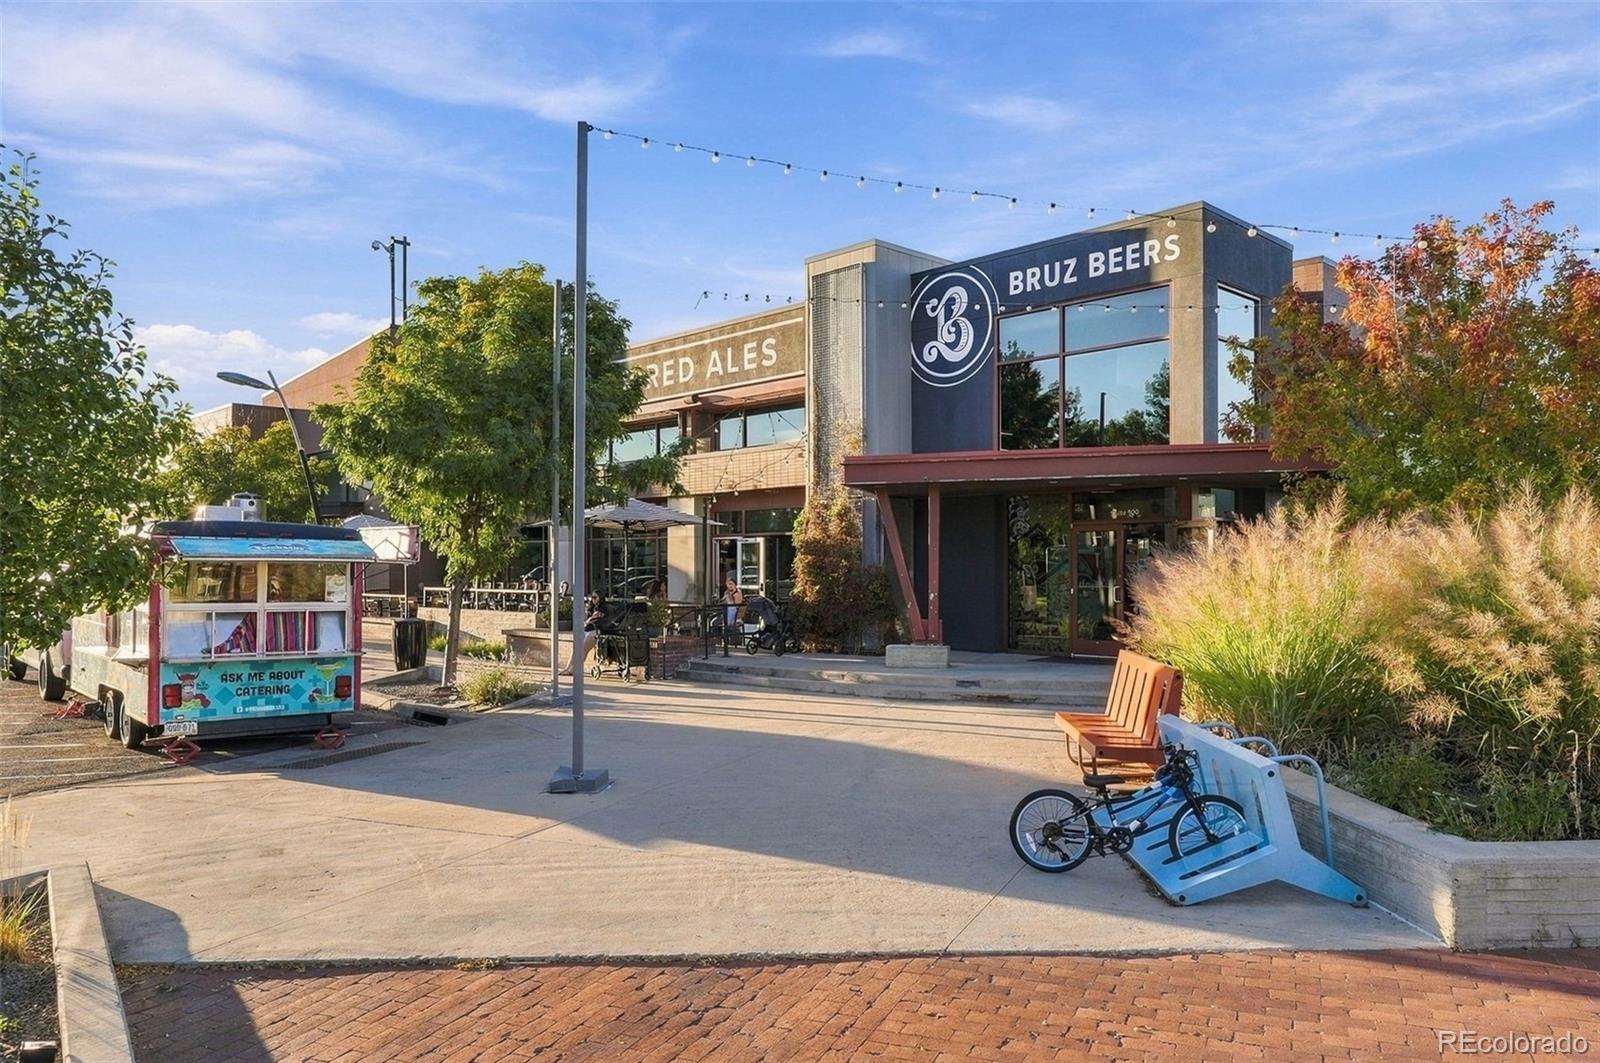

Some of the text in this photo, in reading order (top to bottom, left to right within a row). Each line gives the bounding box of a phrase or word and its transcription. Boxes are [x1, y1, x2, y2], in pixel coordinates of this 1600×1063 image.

[1008, 233, 1181, 296] BRUZ BEERS
[705, 337, 778, 378] ALES
[220, 670, 305, 683] ASK ME ABOUT
[235, 684, 290, 697] CATERING
